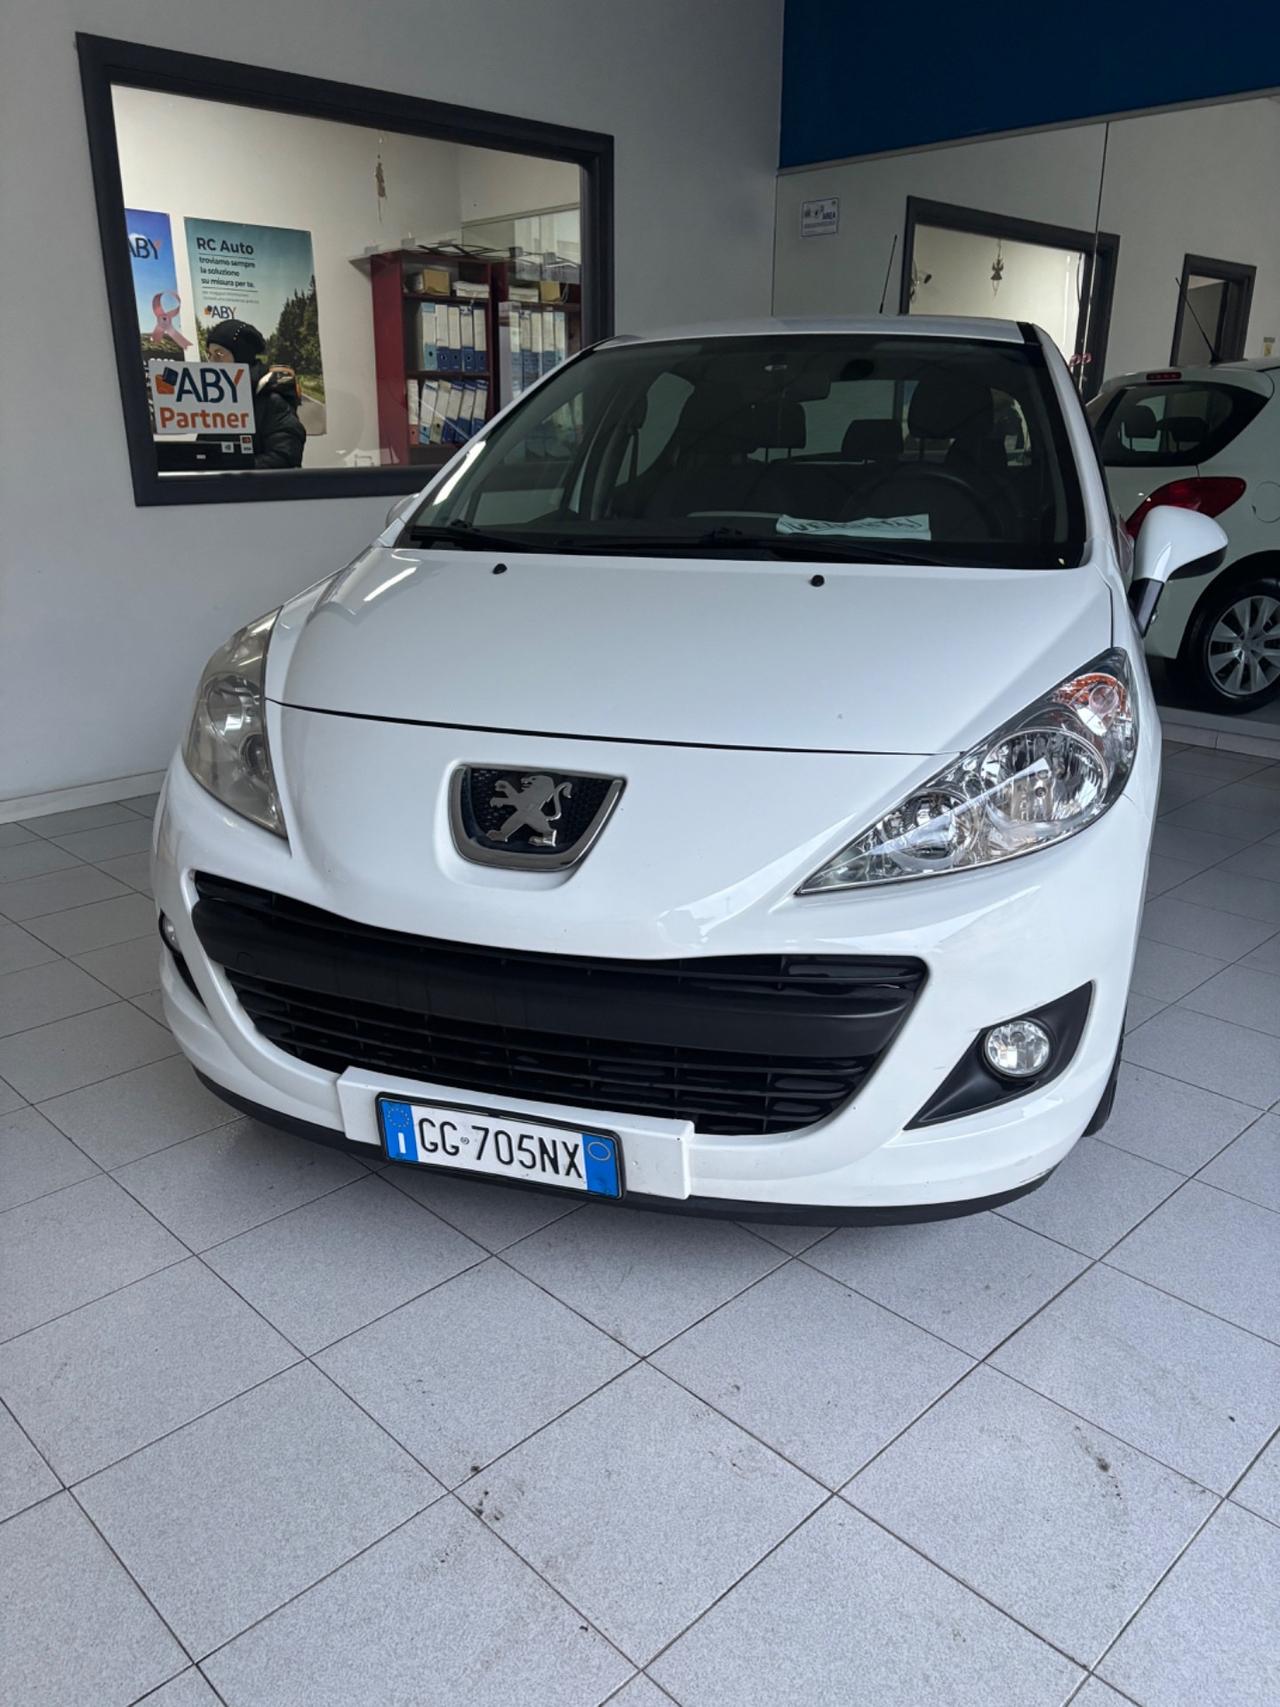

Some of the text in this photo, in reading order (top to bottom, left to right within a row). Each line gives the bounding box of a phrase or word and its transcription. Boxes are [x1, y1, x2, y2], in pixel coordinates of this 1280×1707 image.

[196, 237, 255, 255] RC Auto
[199, 257, 256, 269] troviamo sempre
[200, 266, 240, 277] la soluzione
[210, 278, 234, 287] misura
[211, 305, 237, 320] ABY
[176, 367, 244, 403] ABY
[160, 406, 249, 429] Partner
